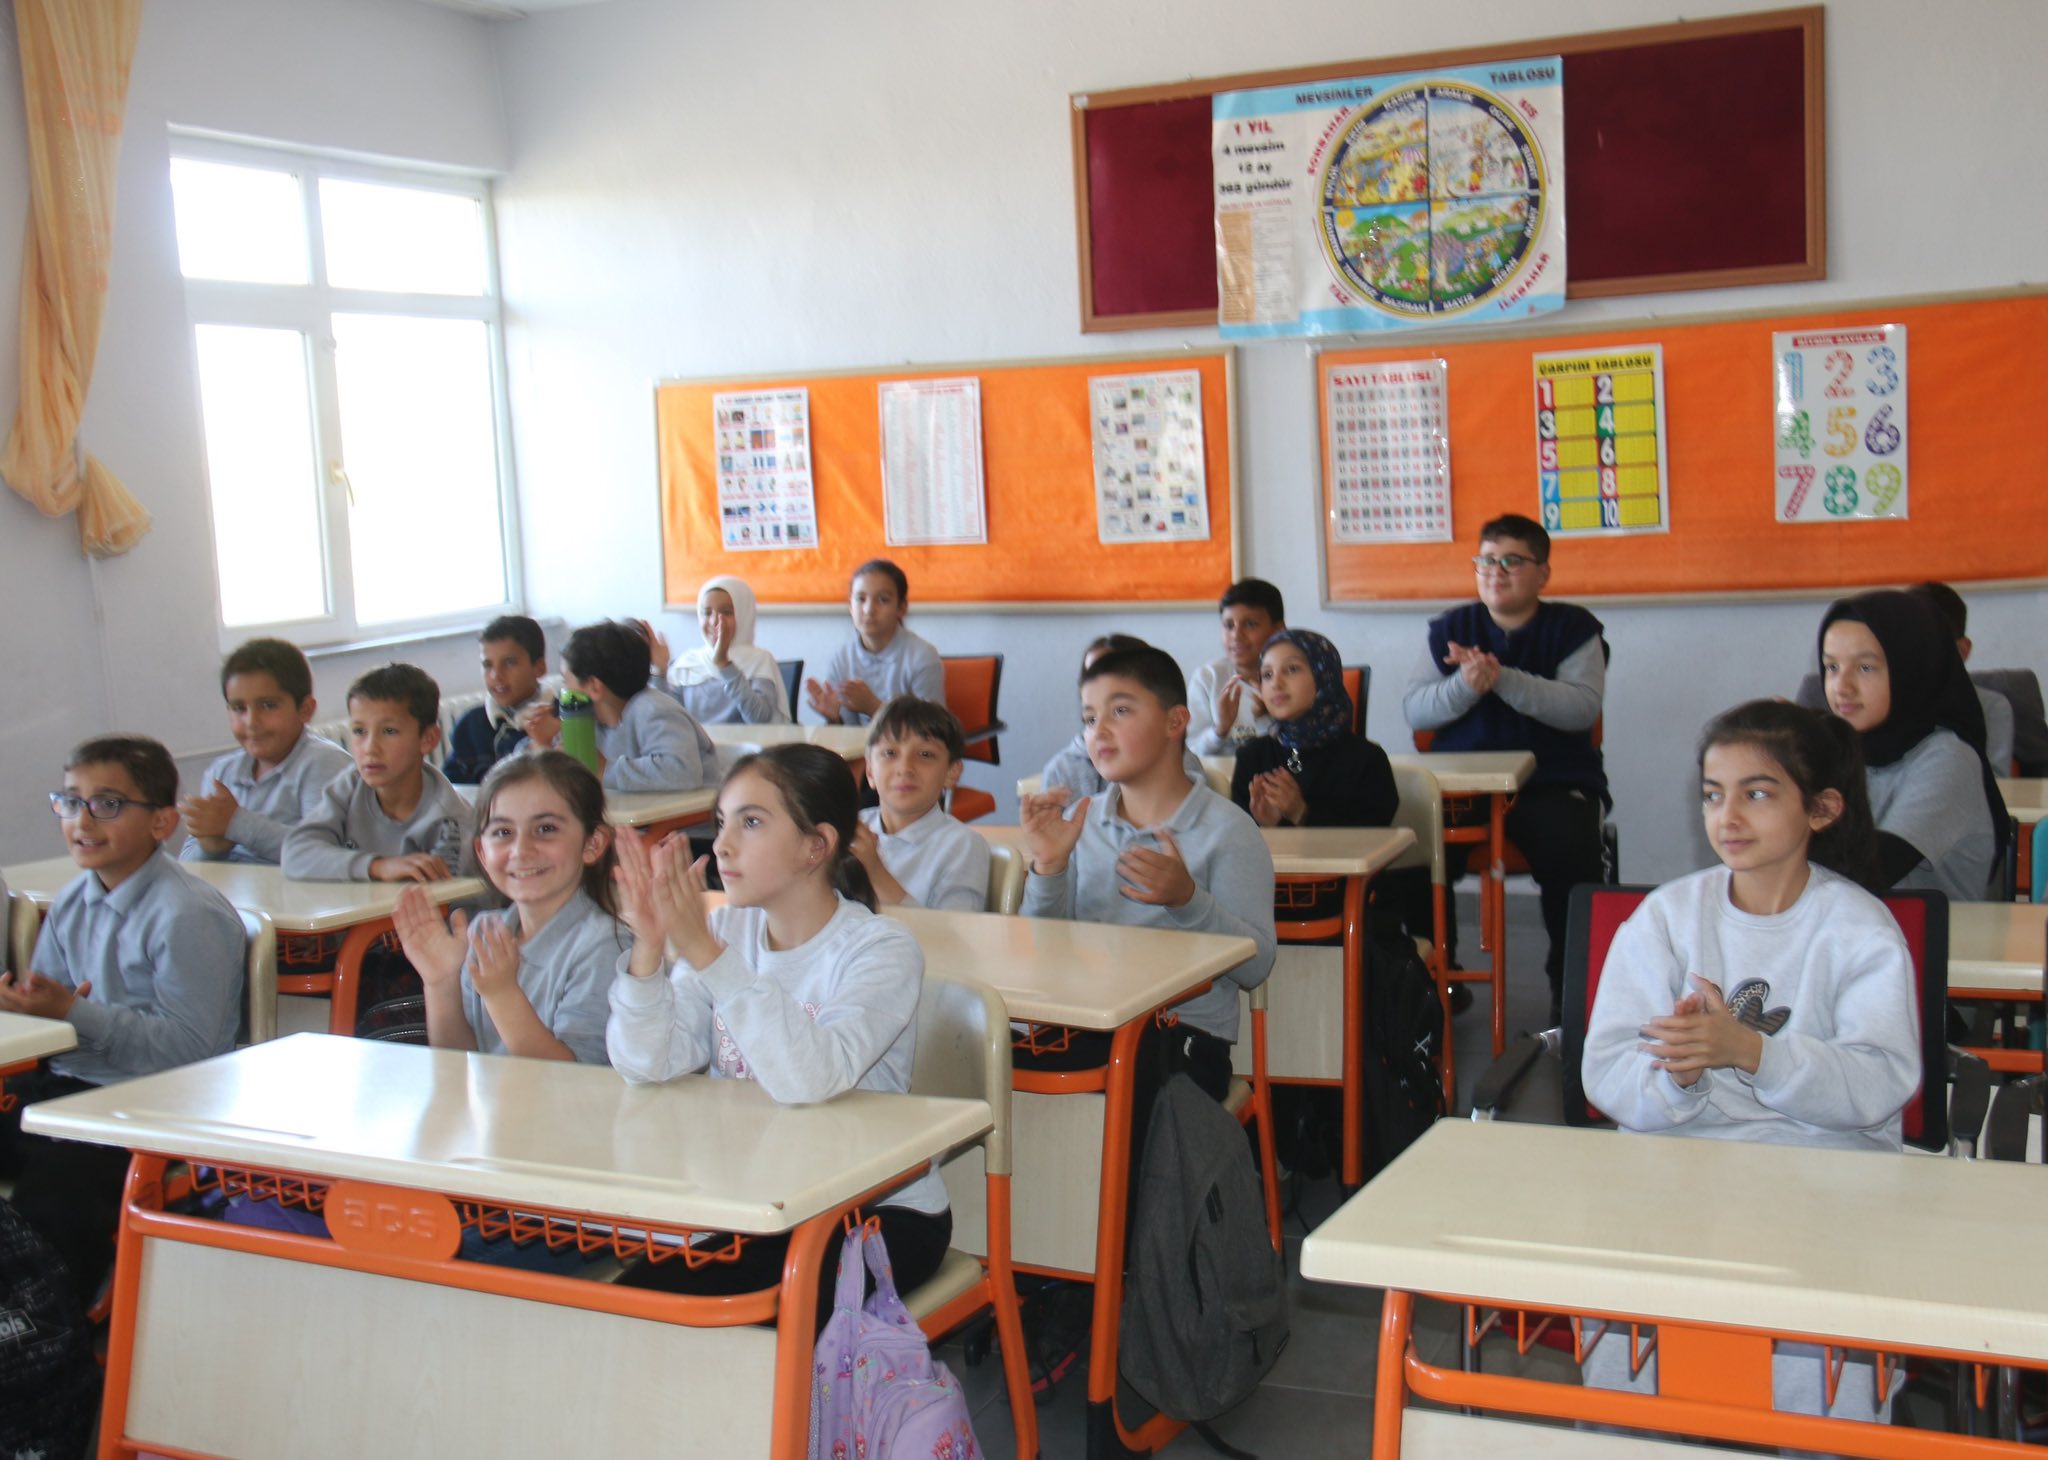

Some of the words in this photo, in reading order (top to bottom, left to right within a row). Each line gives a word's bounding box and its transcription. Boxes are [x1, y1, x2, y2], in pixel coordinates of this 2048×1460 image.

[1489, 67, 1555, 84] TABLOSU
[1247, 119, 1273, 135] YIL
[1783, 351, 1803, 401] 1
[1824, 350, 1854, 399] 2
[1866, 345, 1898, 396] 3
[1539, 379, 1552, 409] 1
[1597, 375, 1613, 403] 2
[1540, 410, 1555, 438] 3
[1599, 406, 1614, 435] 4
[1777, 410, 1816, 459] 4
[1824, 406, 1857, 457] 5
[1865, 403, 1900, 455] 6
[1541, 440, 1557, 470] 5
[1600, 437, 1615, 466] 6
[1543, 473, 1557, 500] 7
[1602, 467, 1616, 496] 8
[1777, 464, 1815, 519] 7
[1823, 464, 1858, 515] 8
[1865, 462, 1901, 515] 9
[1545, 502, 1559, 530] 9
[1602, 499, 1619, 527] 10
